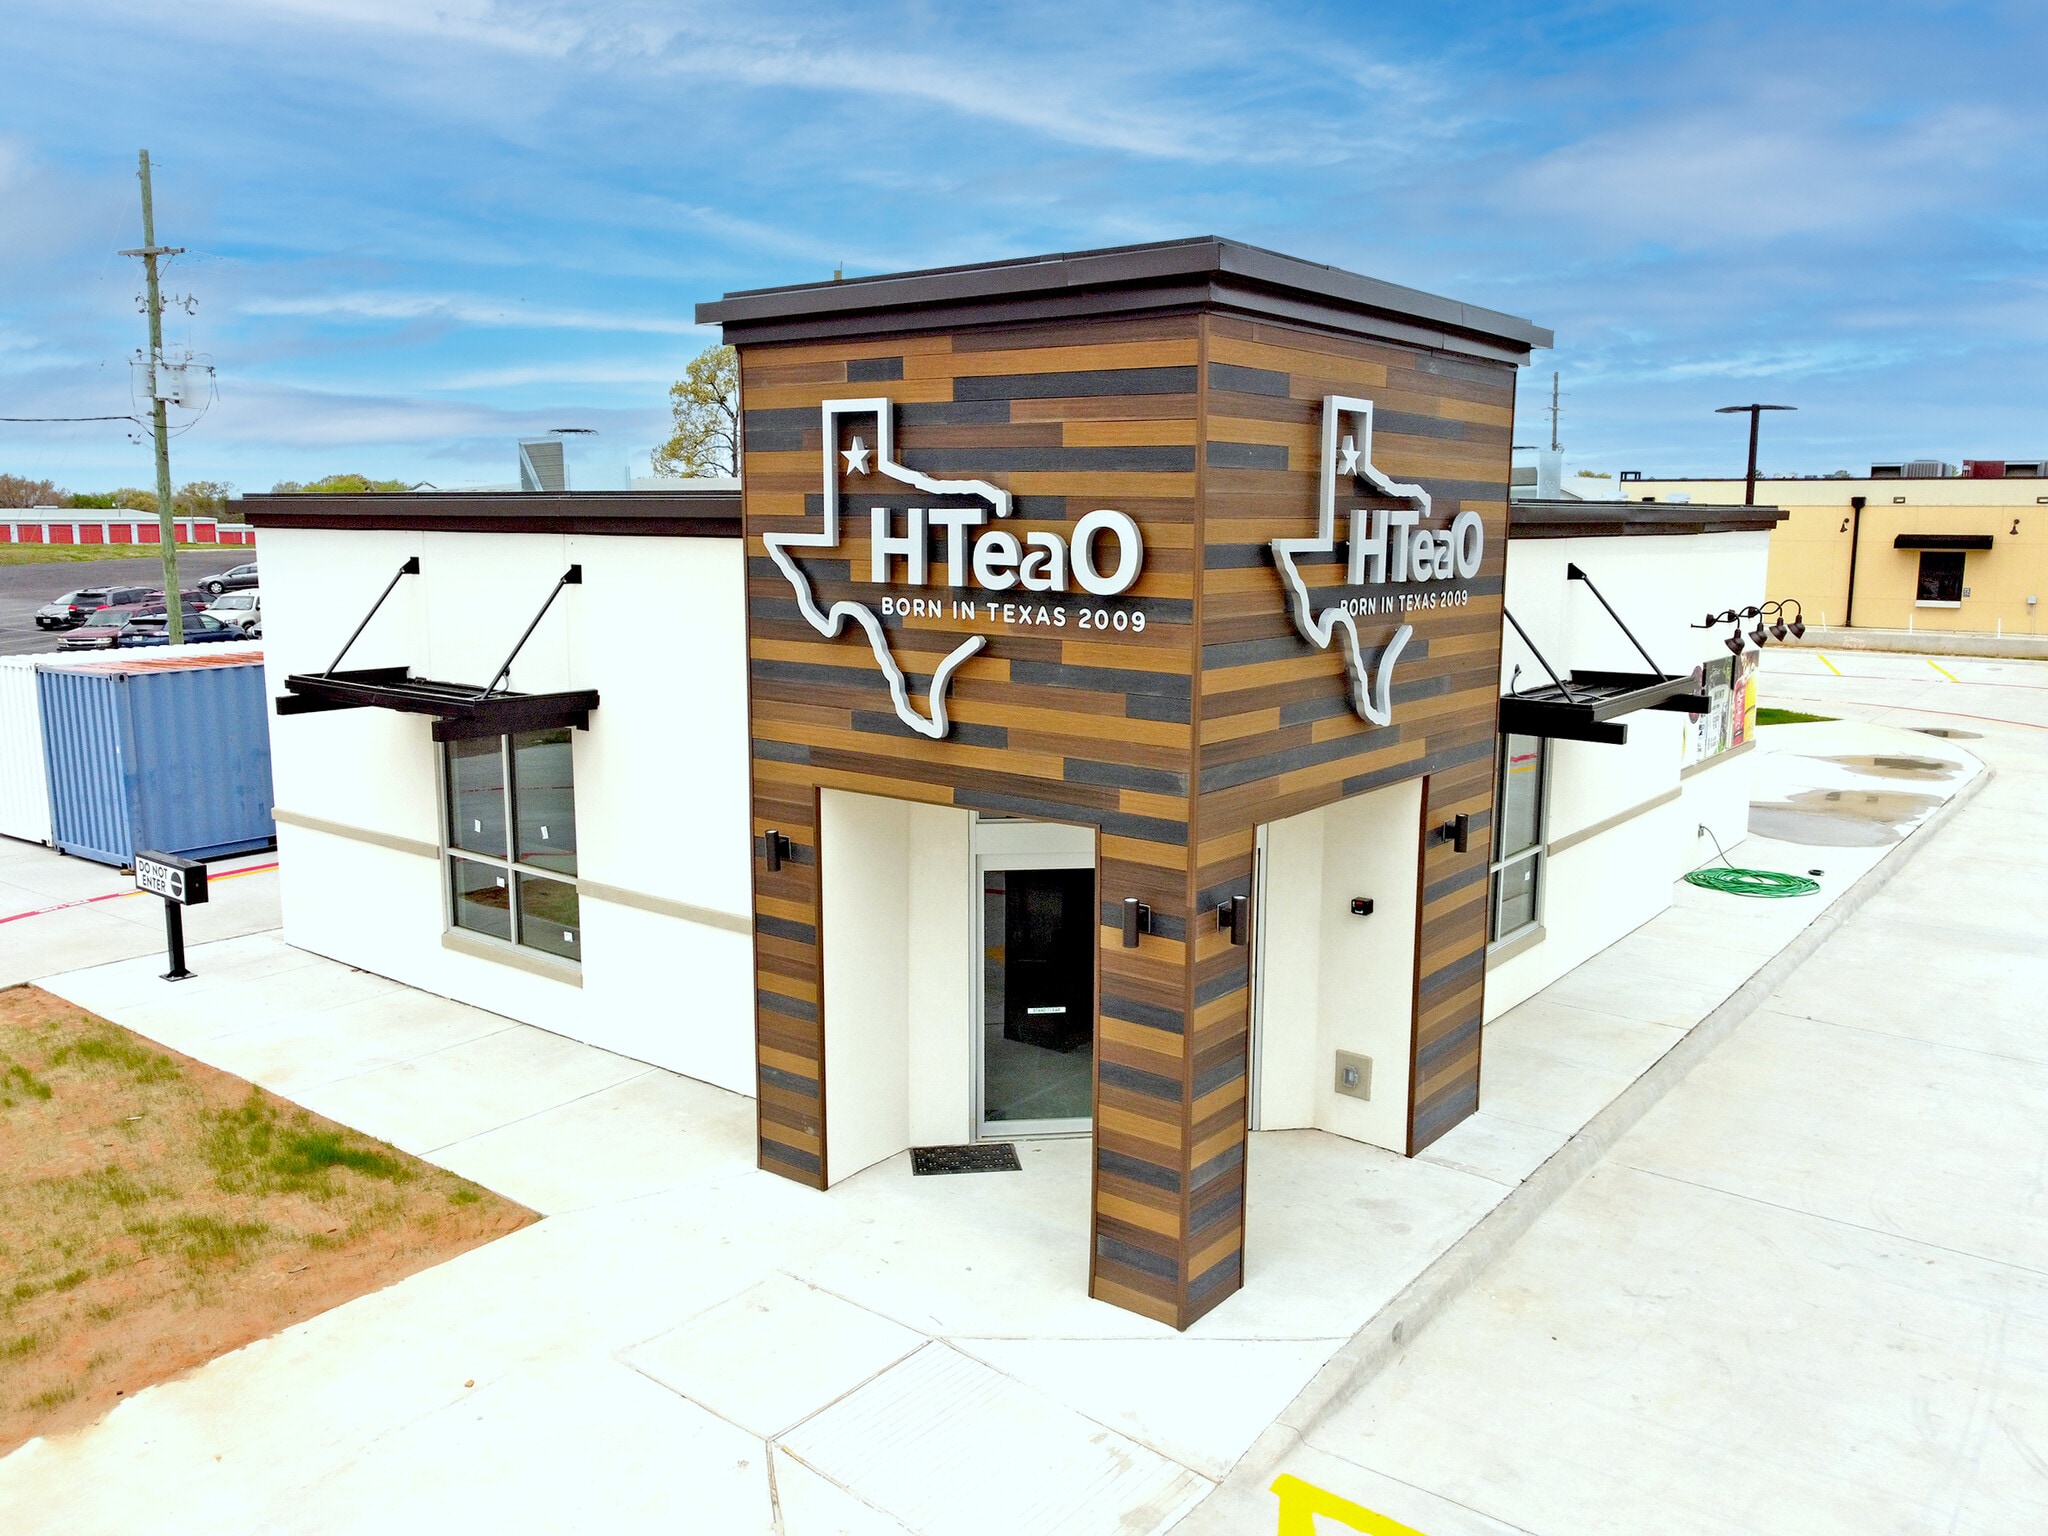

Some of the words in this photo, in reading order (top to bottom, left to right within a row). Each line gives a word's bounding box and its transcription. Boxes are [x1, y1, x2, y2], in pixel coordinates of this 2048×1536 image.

[871, 507, 1143, 595] HTeaO
[1347, 509, 1484, 584] HTeaO
[881, 597, 942, 618] BORN
[952, 600, 976, 620] IN
[986, 602, 1066, 627] TEXAS
[1078, 608, 1146, 632] 2009
[1381, 596, 1394, 613] IN
[1399, 592, 1436, 612] TEXAS
[1440, 589, 1468, 608] 2009
[139, 860, 150, 873] DO
[152, 865, 168, 879] NOT
[142, 874, 166, 892] ENTER
